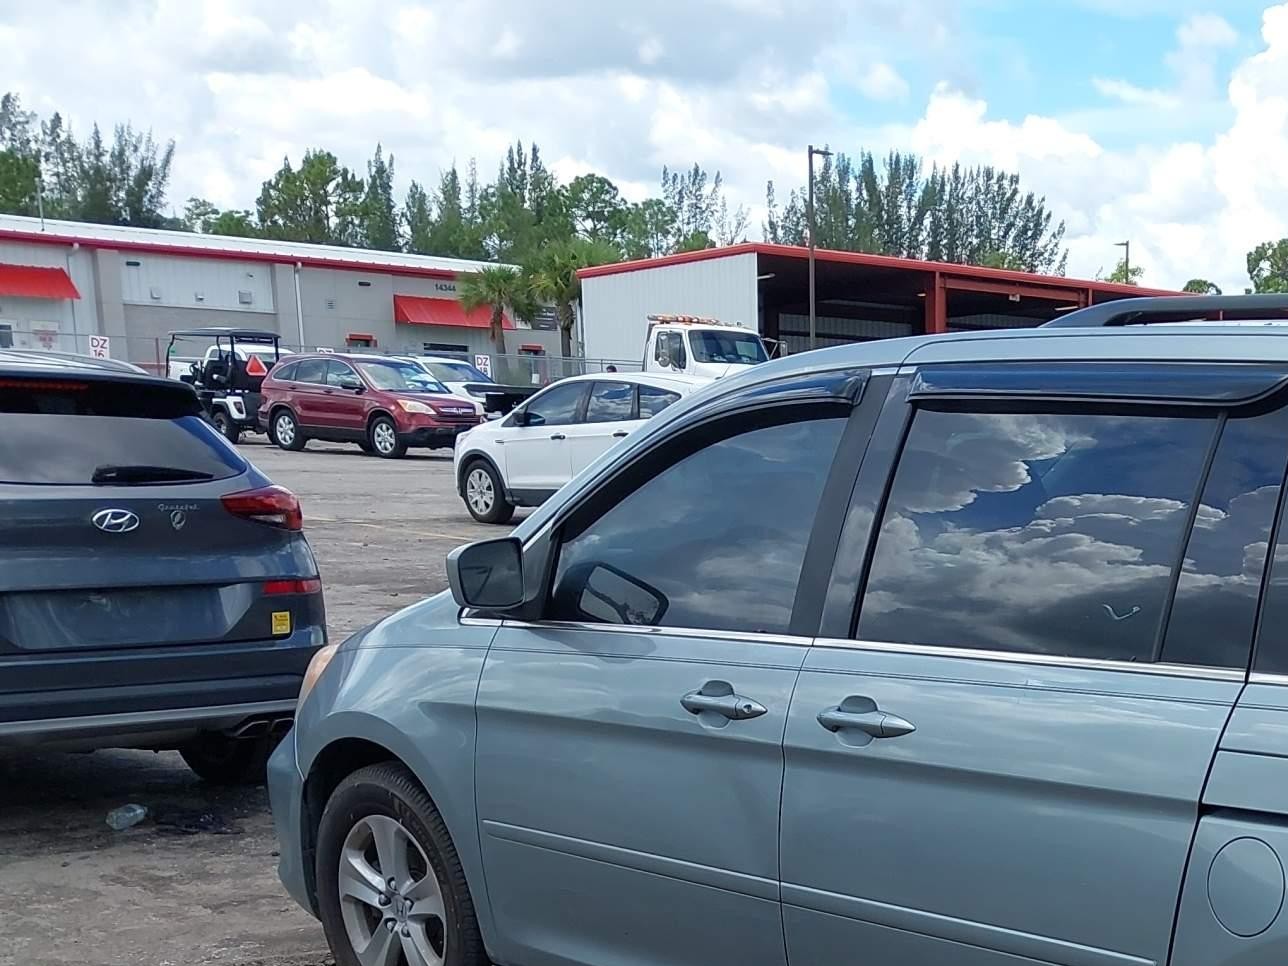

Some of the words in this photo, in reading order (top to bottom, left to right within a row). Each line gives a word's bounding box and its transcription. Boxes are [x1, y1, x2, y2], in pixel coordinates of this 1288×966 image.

[435, 282, 456, 292] 14344
[91, 337, 108, 349] DZ
[477, 357, 488, 367] DZ
